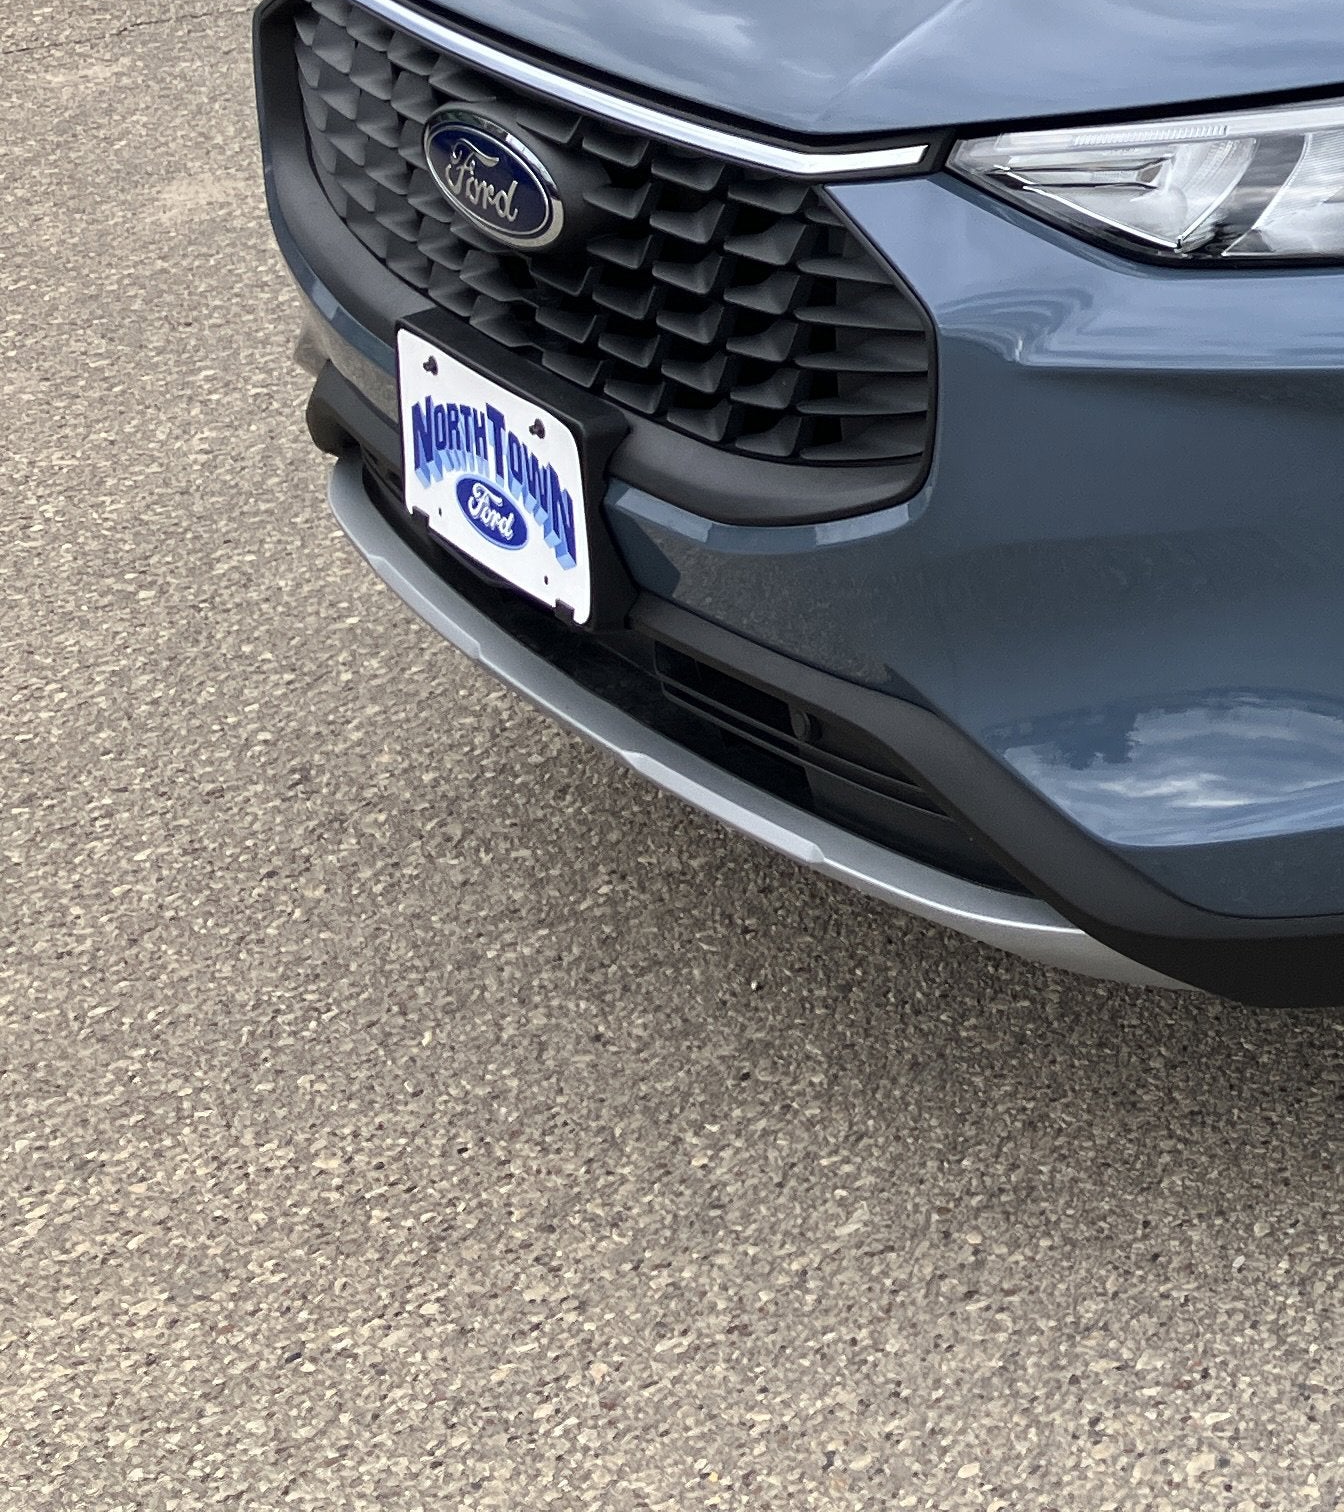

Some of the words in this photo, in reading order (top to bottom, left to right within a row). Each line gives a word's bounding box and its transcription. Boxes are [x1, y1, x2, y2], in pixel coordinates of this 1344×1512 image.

[445, 137, 519, 223] Ford
[411, 395, 577, 569] NORTHTOWN
[470, 482, 515, 541] Ford
